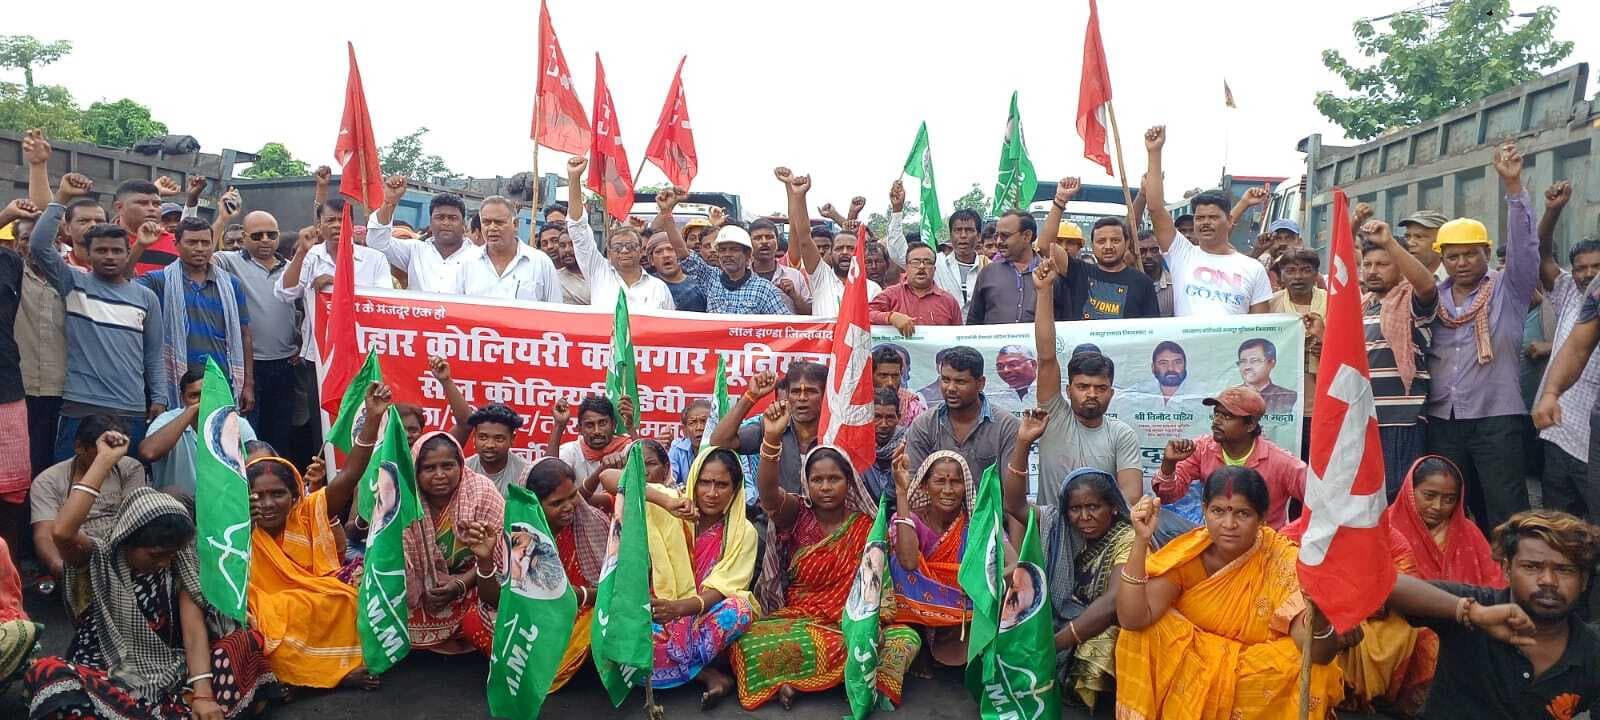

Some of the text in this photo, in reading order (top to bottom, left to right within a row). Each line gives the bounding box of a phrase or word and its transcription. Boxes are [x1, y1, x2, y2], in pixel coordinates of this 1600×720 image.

[362, 300, 375, 313] के
[376, 303, 410, 319] मजदूर
[412, 305, 433, 317] एक
[434, 304, 446, 320] हो
[728, 327, 753, 338] लाल
[422, 325, 574, 368] कोलियरी
